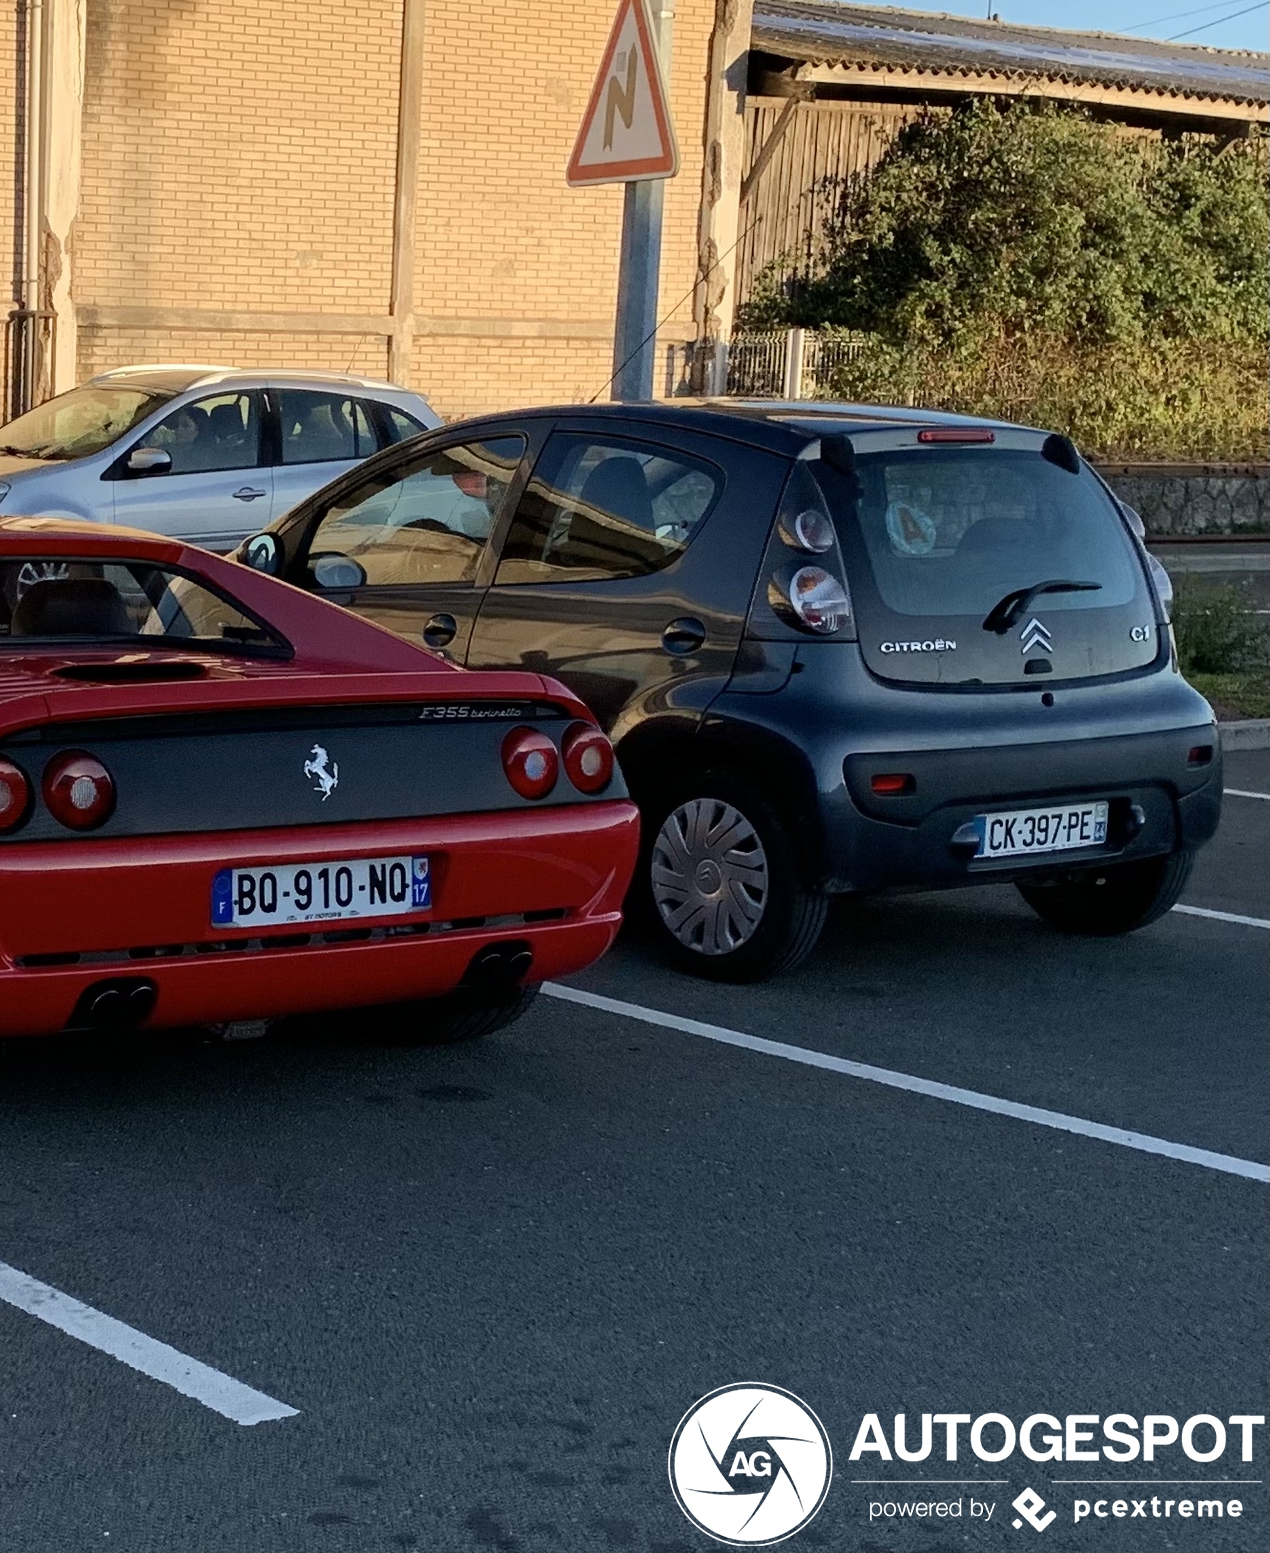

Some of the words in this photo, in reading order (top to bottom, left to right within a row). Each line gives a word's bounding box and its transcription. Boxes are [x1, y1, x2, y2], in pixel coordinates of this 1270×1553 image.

[1131, 625, 1150, 642] C1
[880, 638, 957, 653] CITROËN
[419, 706, 470, 719] F355
[413, 883, 428, 903] 17
[219, 902, 226, 914] F
